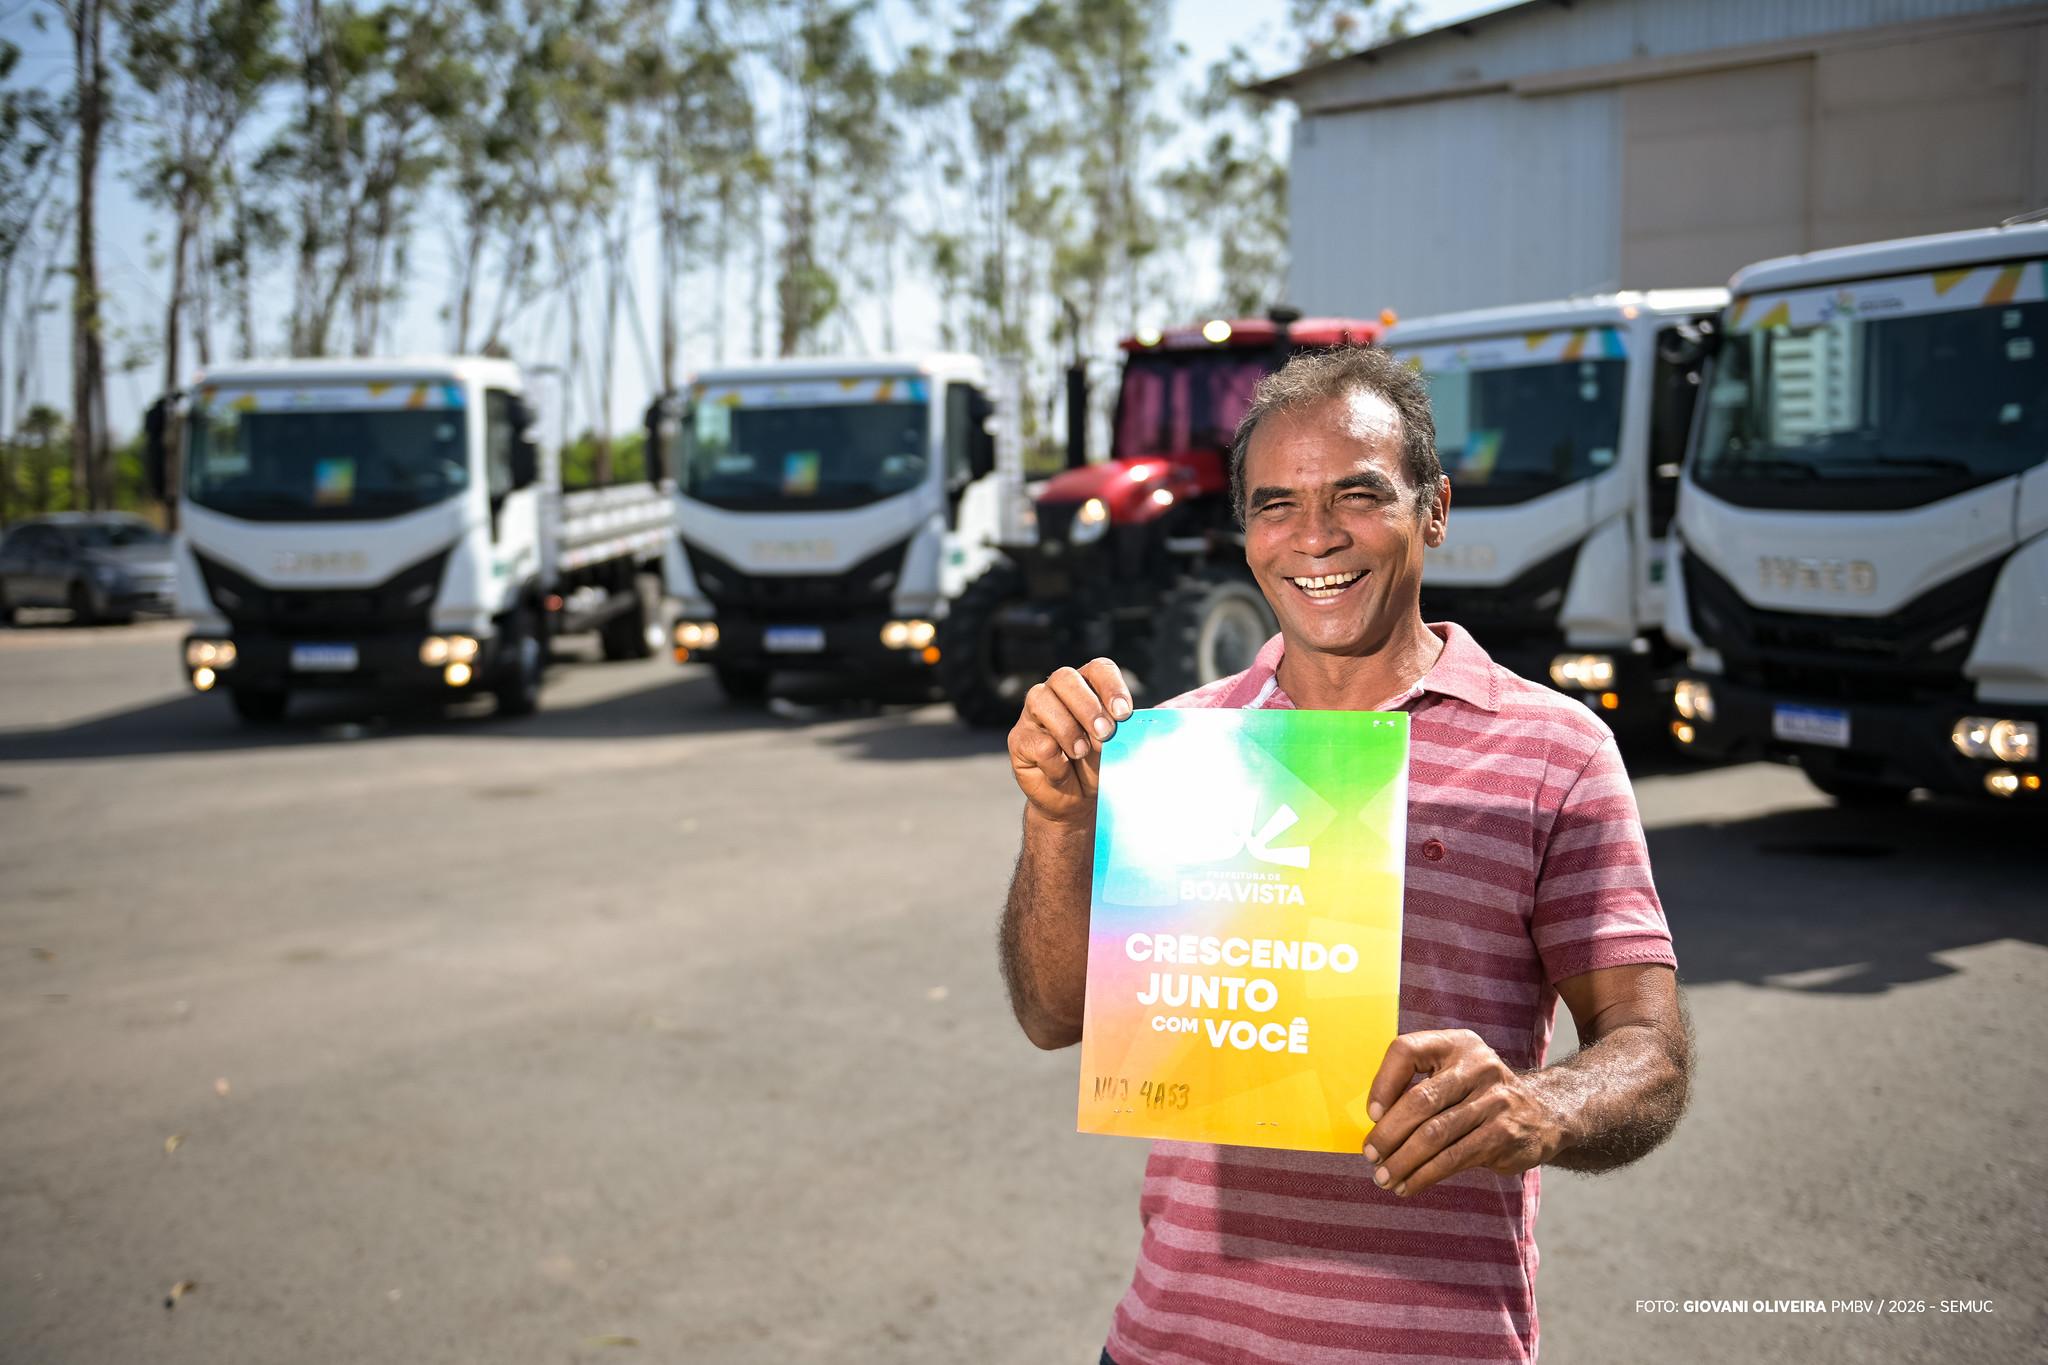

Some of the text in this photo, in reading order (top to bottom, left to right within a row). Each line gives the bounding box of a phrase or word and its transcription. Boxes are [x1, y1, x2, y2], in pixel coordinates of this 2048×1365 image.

[1207, 871, 1281, 881] PREFEITURA DE
[1125, 932, 1359, 973] CRESCENDO
[1136, 972, 1278, 1012] JUNTO
[1151, 1015, 1309, 1054] COM VOCÊ
[1140, 1080, 1190, 1110] 4A53
